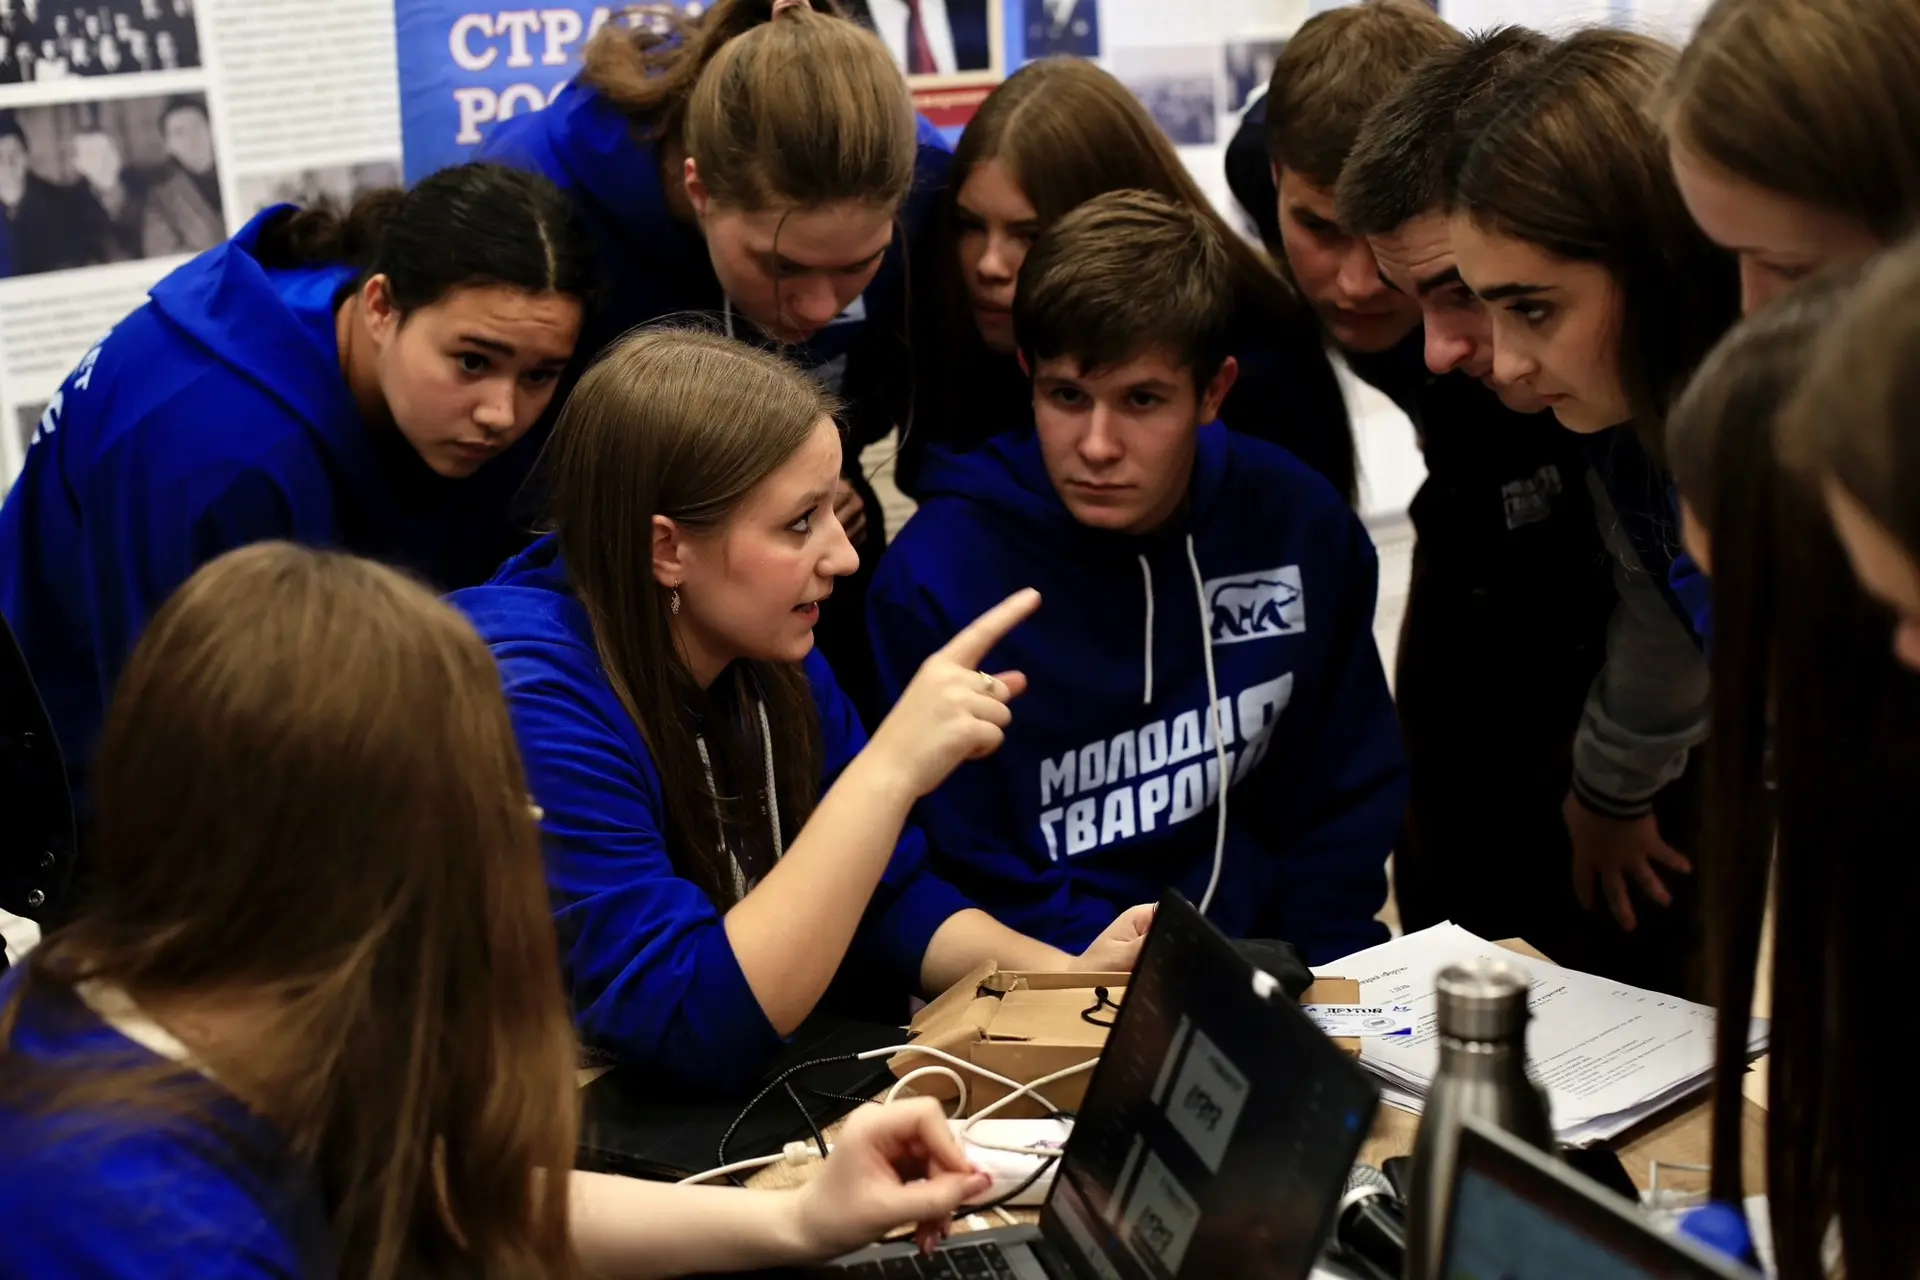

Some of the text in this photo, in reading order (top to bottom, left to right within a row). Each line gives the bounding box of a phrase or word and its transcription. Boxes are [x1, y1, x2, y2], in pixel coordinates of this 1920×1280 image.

[449, 1, 703, 71] СТР
[453, 81, 569, 145] РО
[1040, 671, 1294, 806] МОЛОДАЯ
